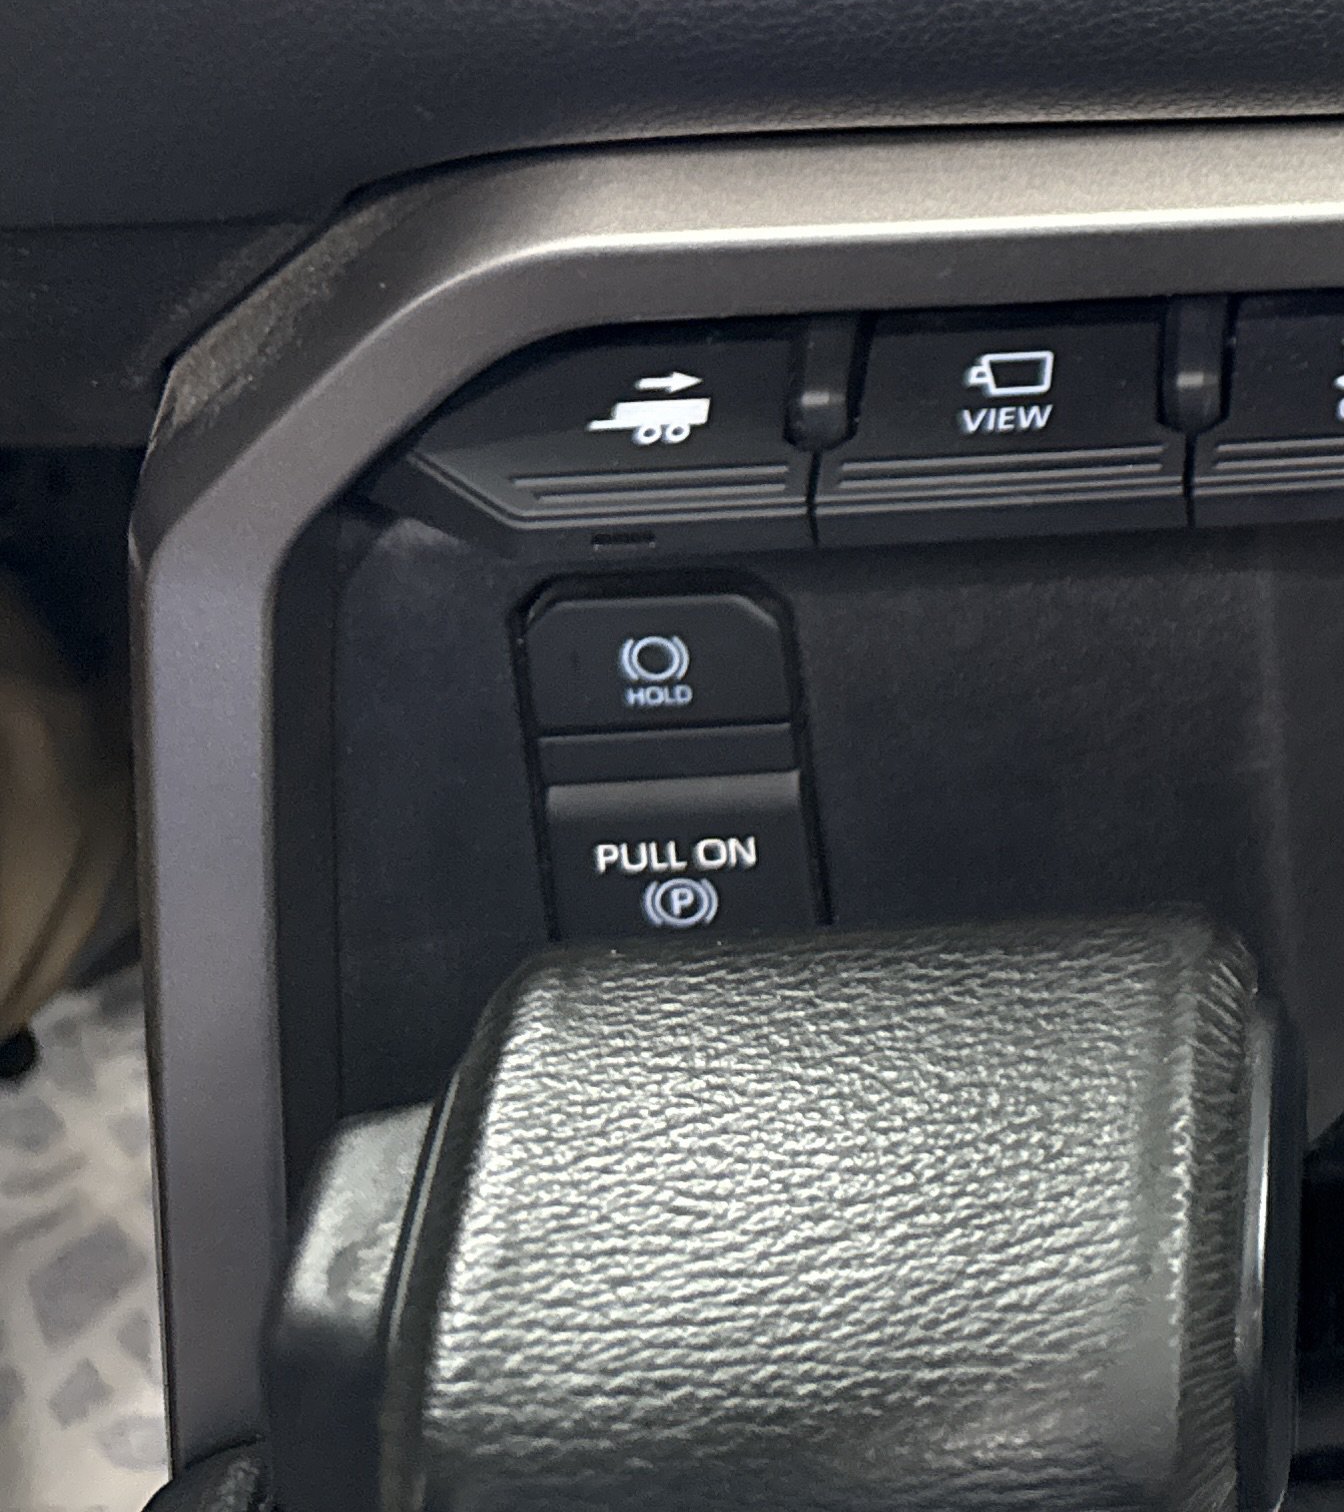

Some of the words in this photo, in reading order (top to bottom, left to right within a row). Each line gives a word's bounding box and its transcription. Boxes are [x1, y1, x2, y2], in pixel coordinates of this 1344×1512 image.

[960, 406, 1054, 433] VIEW
[626, 684, 694, 707] HOLD
[596, 841, 688, 875] PULL
[696, 836, 757, 871] ON
